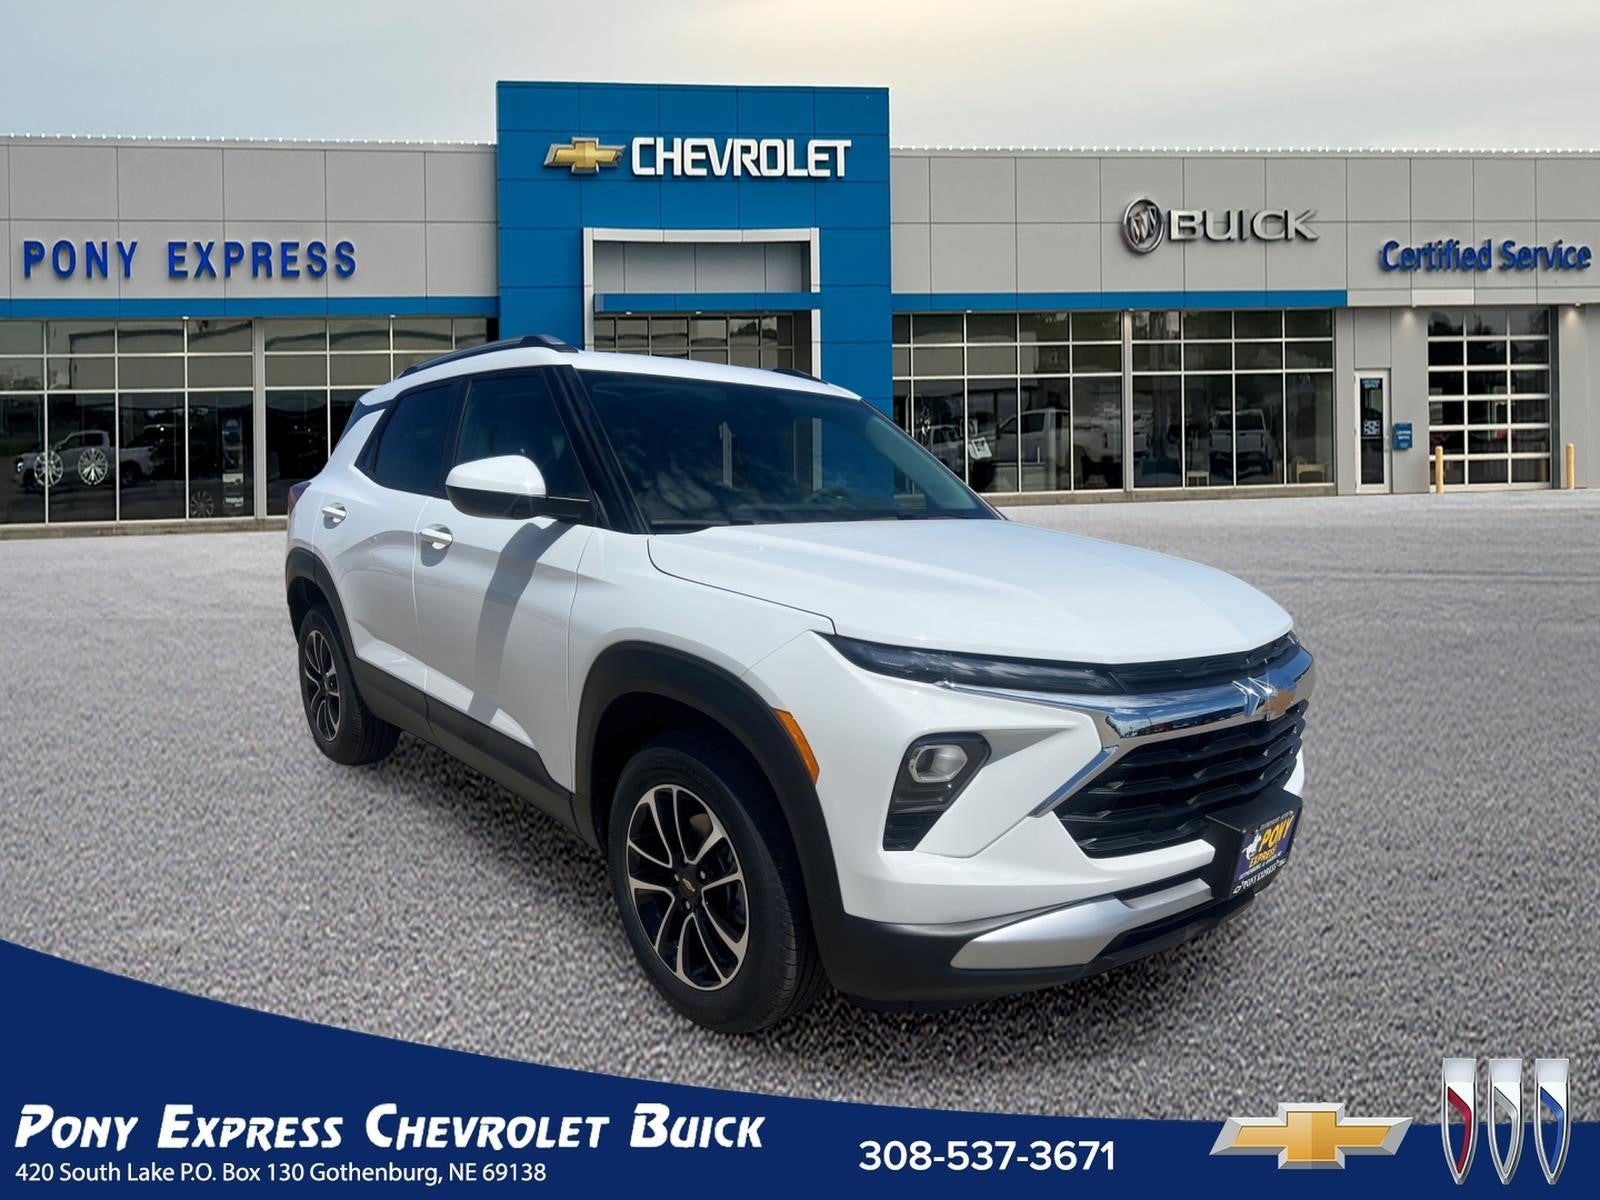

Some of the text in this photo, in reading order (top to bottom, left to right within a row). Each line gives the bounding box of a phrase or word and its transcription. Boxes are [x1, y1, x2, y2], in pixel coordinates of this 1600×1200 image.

[631, 137, 852, 177] CHEVROLET
[1168, 208, 1319, 242] BUICK
[23, 240, 357, 279] PONY EXPRESS
[1380, 239, 1592, 272] Certified Service
[1258, 815, 1295, 852] PONY
[1248, 845, 1277, 869] EXPRESS
